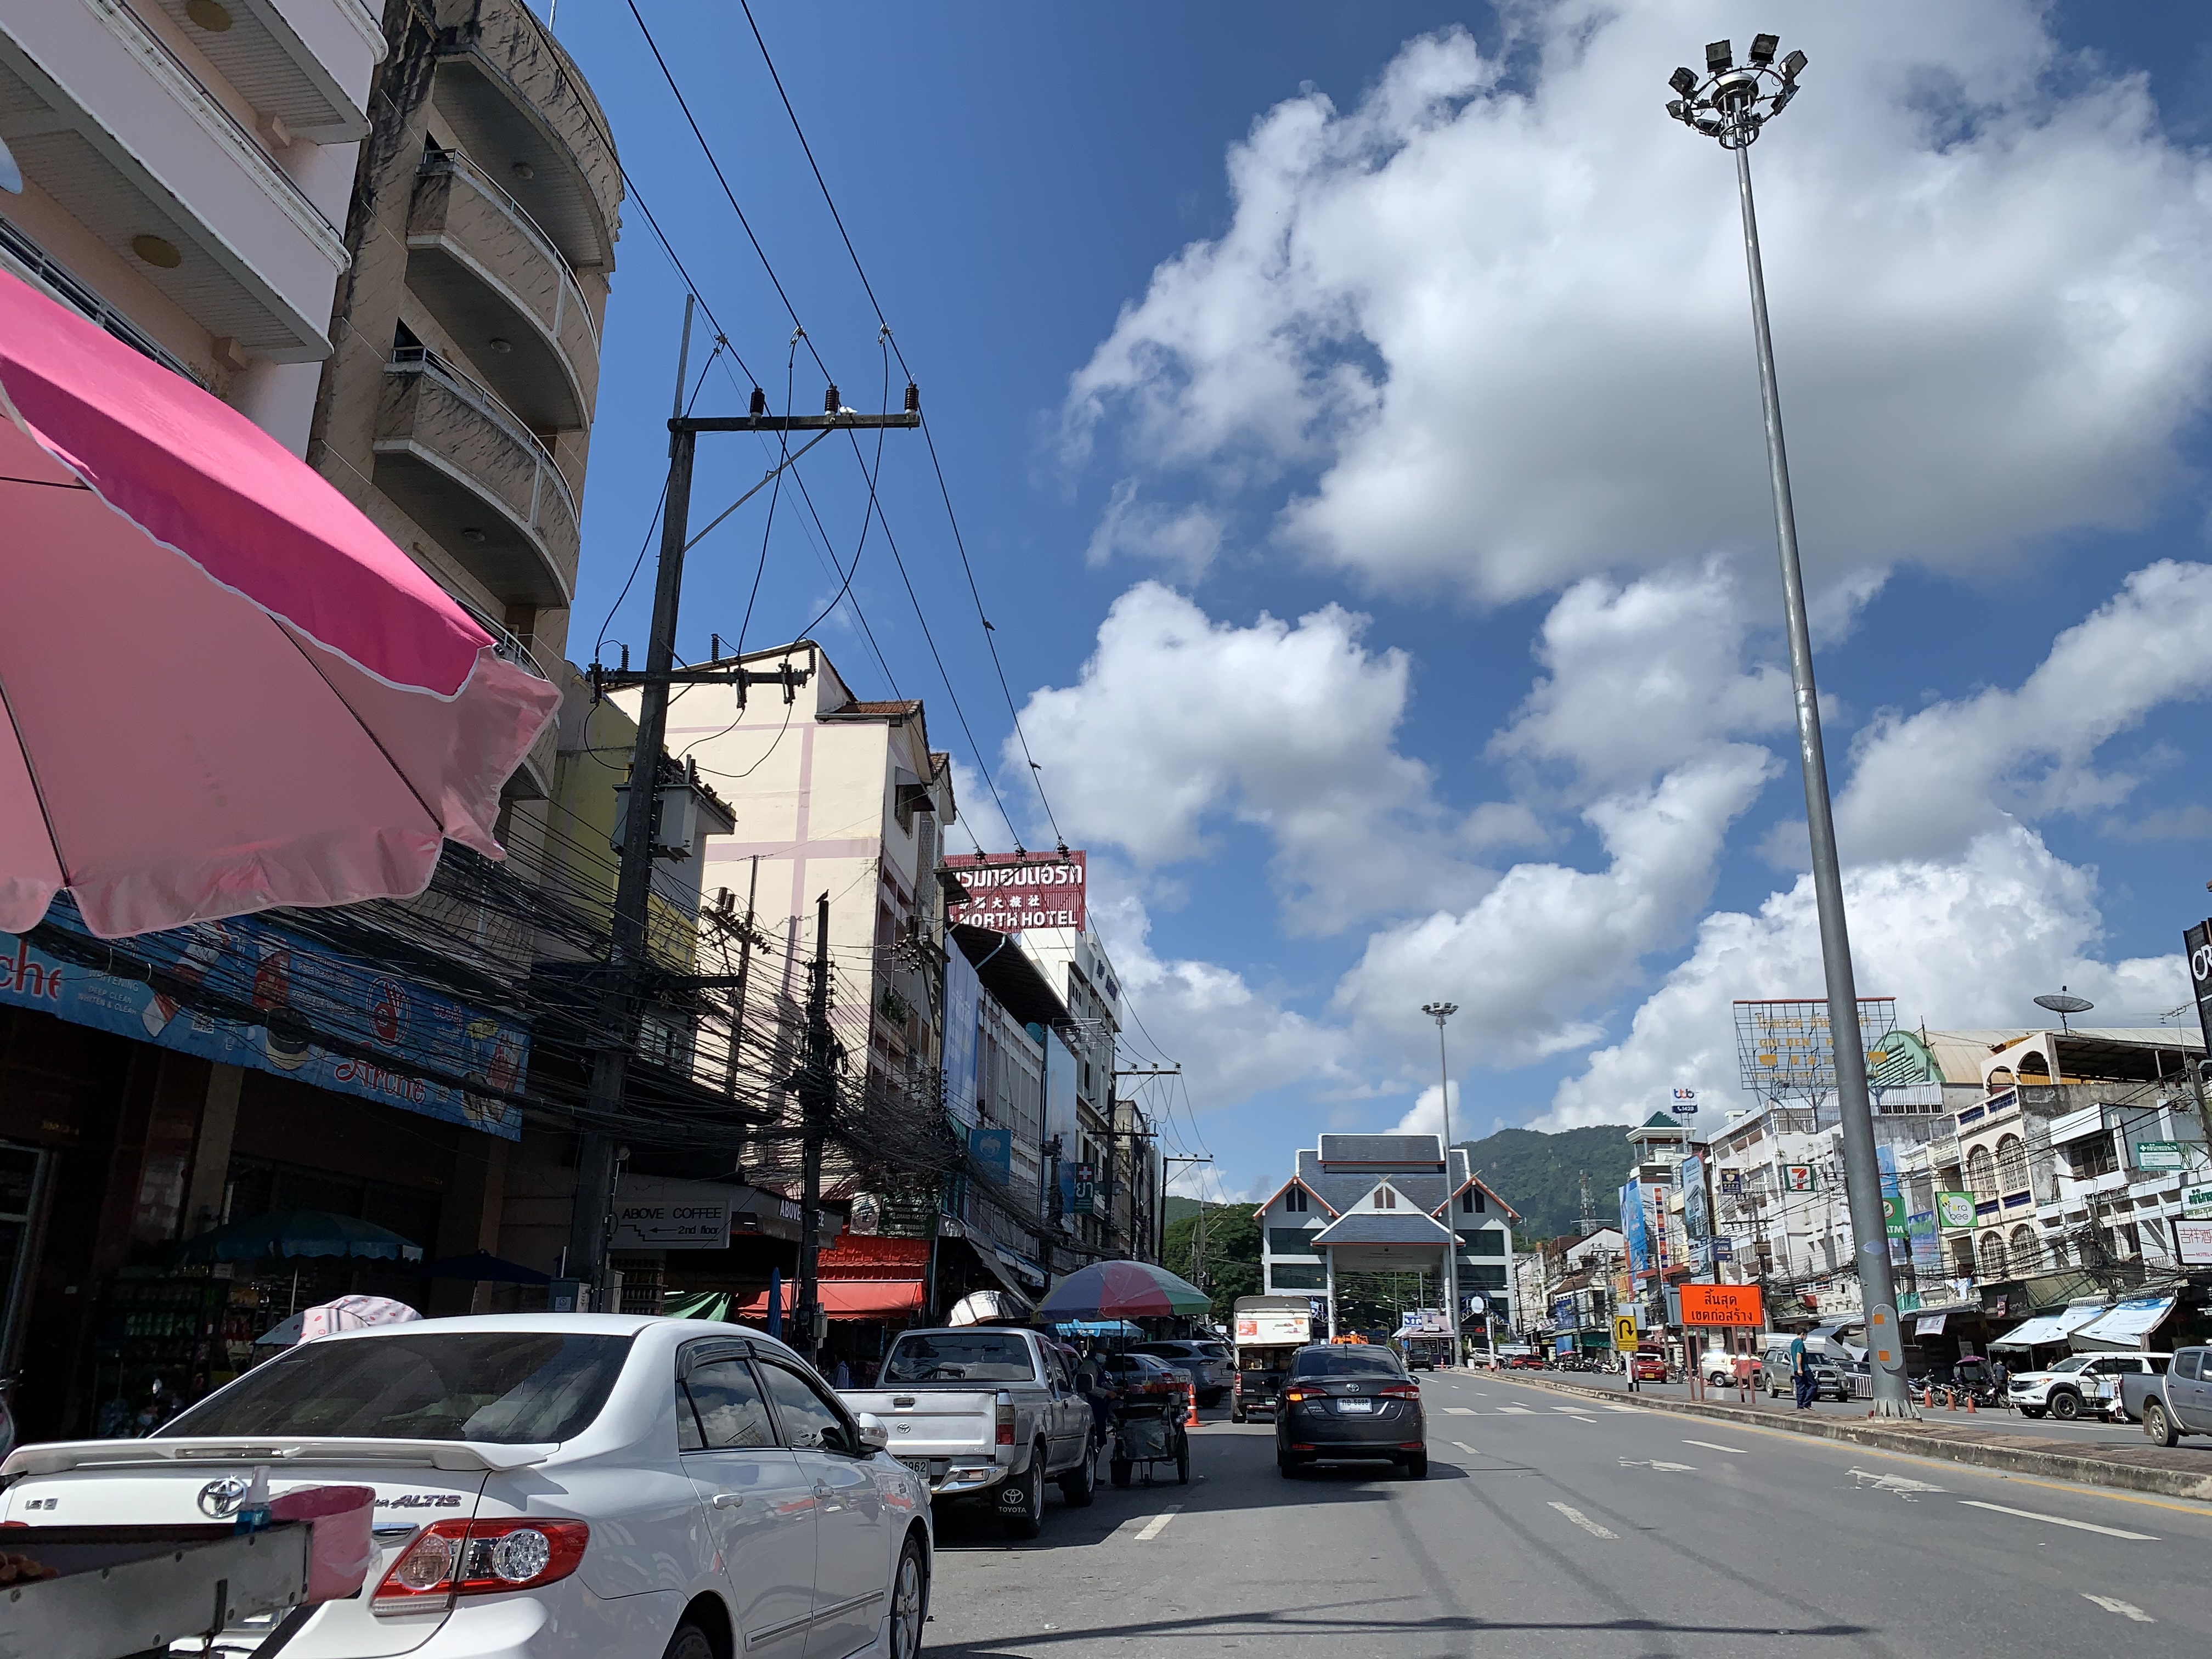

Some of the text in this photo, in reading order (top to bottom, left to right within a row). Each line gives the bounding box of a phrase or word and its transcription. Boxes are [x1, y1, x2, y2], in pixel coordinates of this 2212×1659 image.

[960, 912, 1017, 928] NORTH
[1022, 910, 1077, 926] HOTEL
[88, 985, 132, 1005] DEEP CLEAN
[114, 1003, 137, 1015] CLEAN
[1674, 1088, 1694, 1098] ttb
[1076, 1182, 1093, 1198] ยา
[622, 1207, 723, 1220] ABOVE COFFEE
[780, 1199, 802, 1221] ABOVE
[678, 1225, 719, 1234] 2nd floor
[2179, 1227, 2212, 1244] 吉祥酒
[1705, 1288, 1737, 1309] สิ้นสุด
[1691, 1307, 1752, 1322] เขตก่อสร้าง
[390, 1494, 462, 1509] ALTIS
